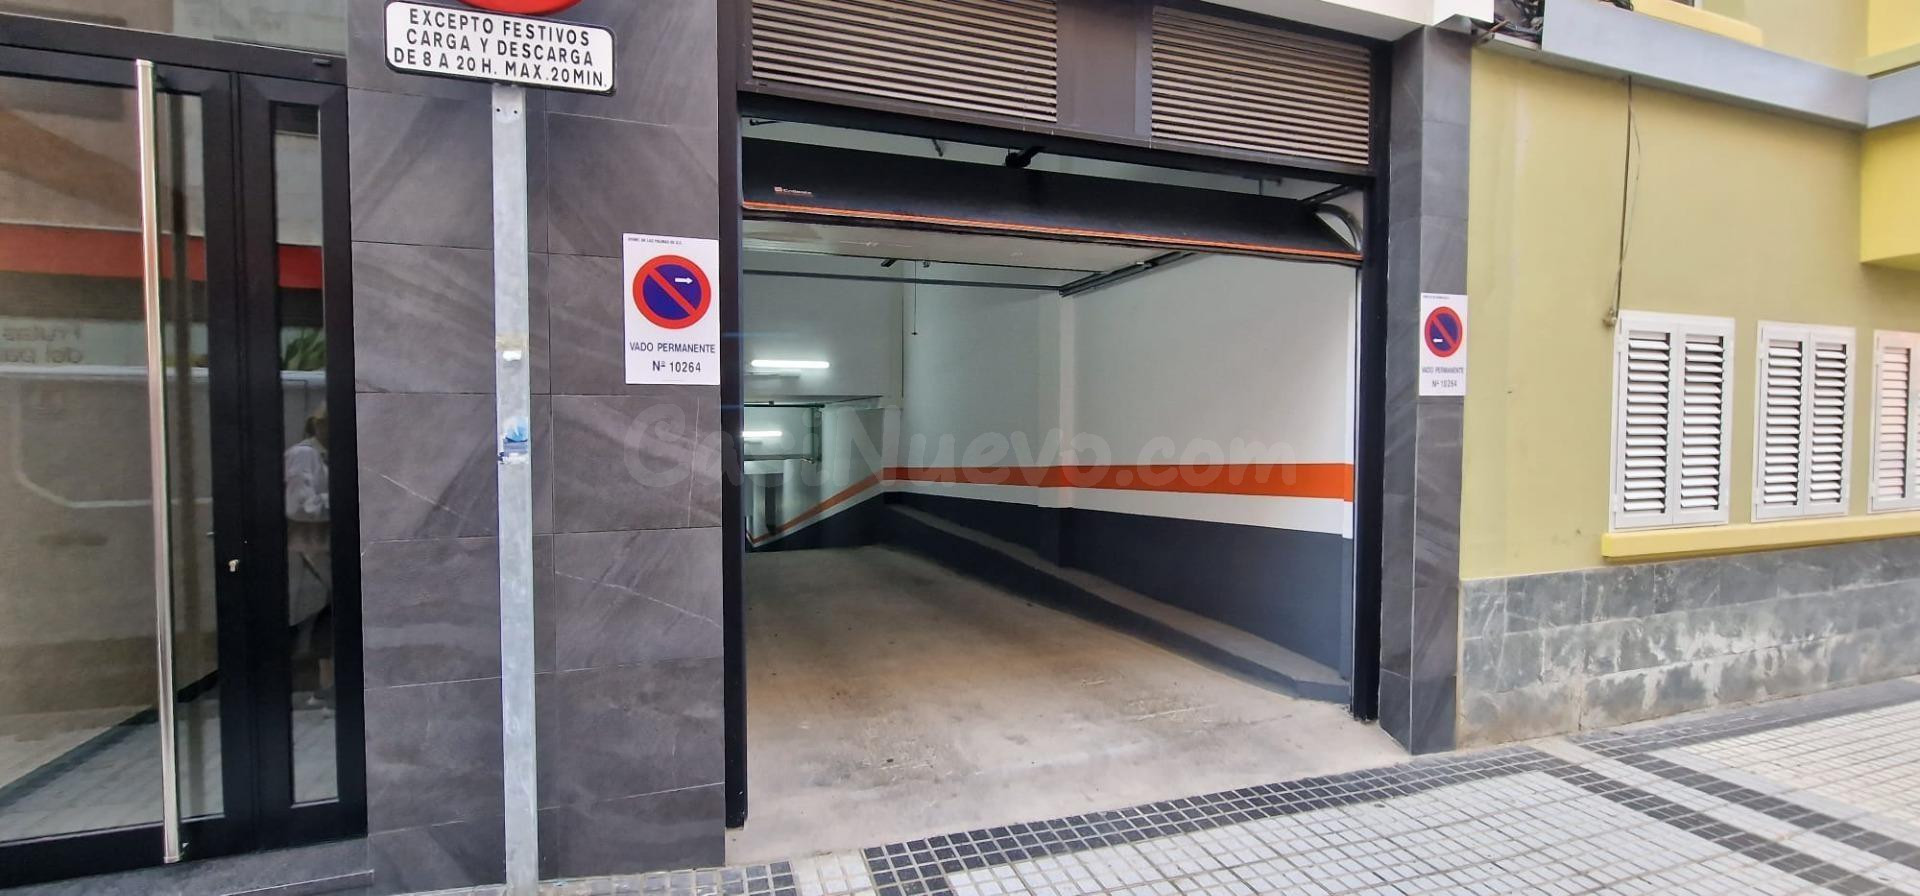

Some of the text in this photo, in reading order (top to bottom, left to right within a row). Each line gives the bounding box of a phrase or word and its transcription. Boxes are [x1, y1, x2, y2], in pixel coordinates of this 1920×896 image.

[409, 8, 590, 46] EXCEPTO FESTIVOS
[393, 47, 416, 65] DE
[422, 51, 432, 67] 8
[438, 53, 449, 69] A
[456, 55, 476, 71] 20
[482, 58, 497, 75] H.
[406, 28, 593, 66] CARGA Y DESCARGA
[629, 341, 716, 353] VADO PERMANENTE
[669, 361, 702, 373] 10264
